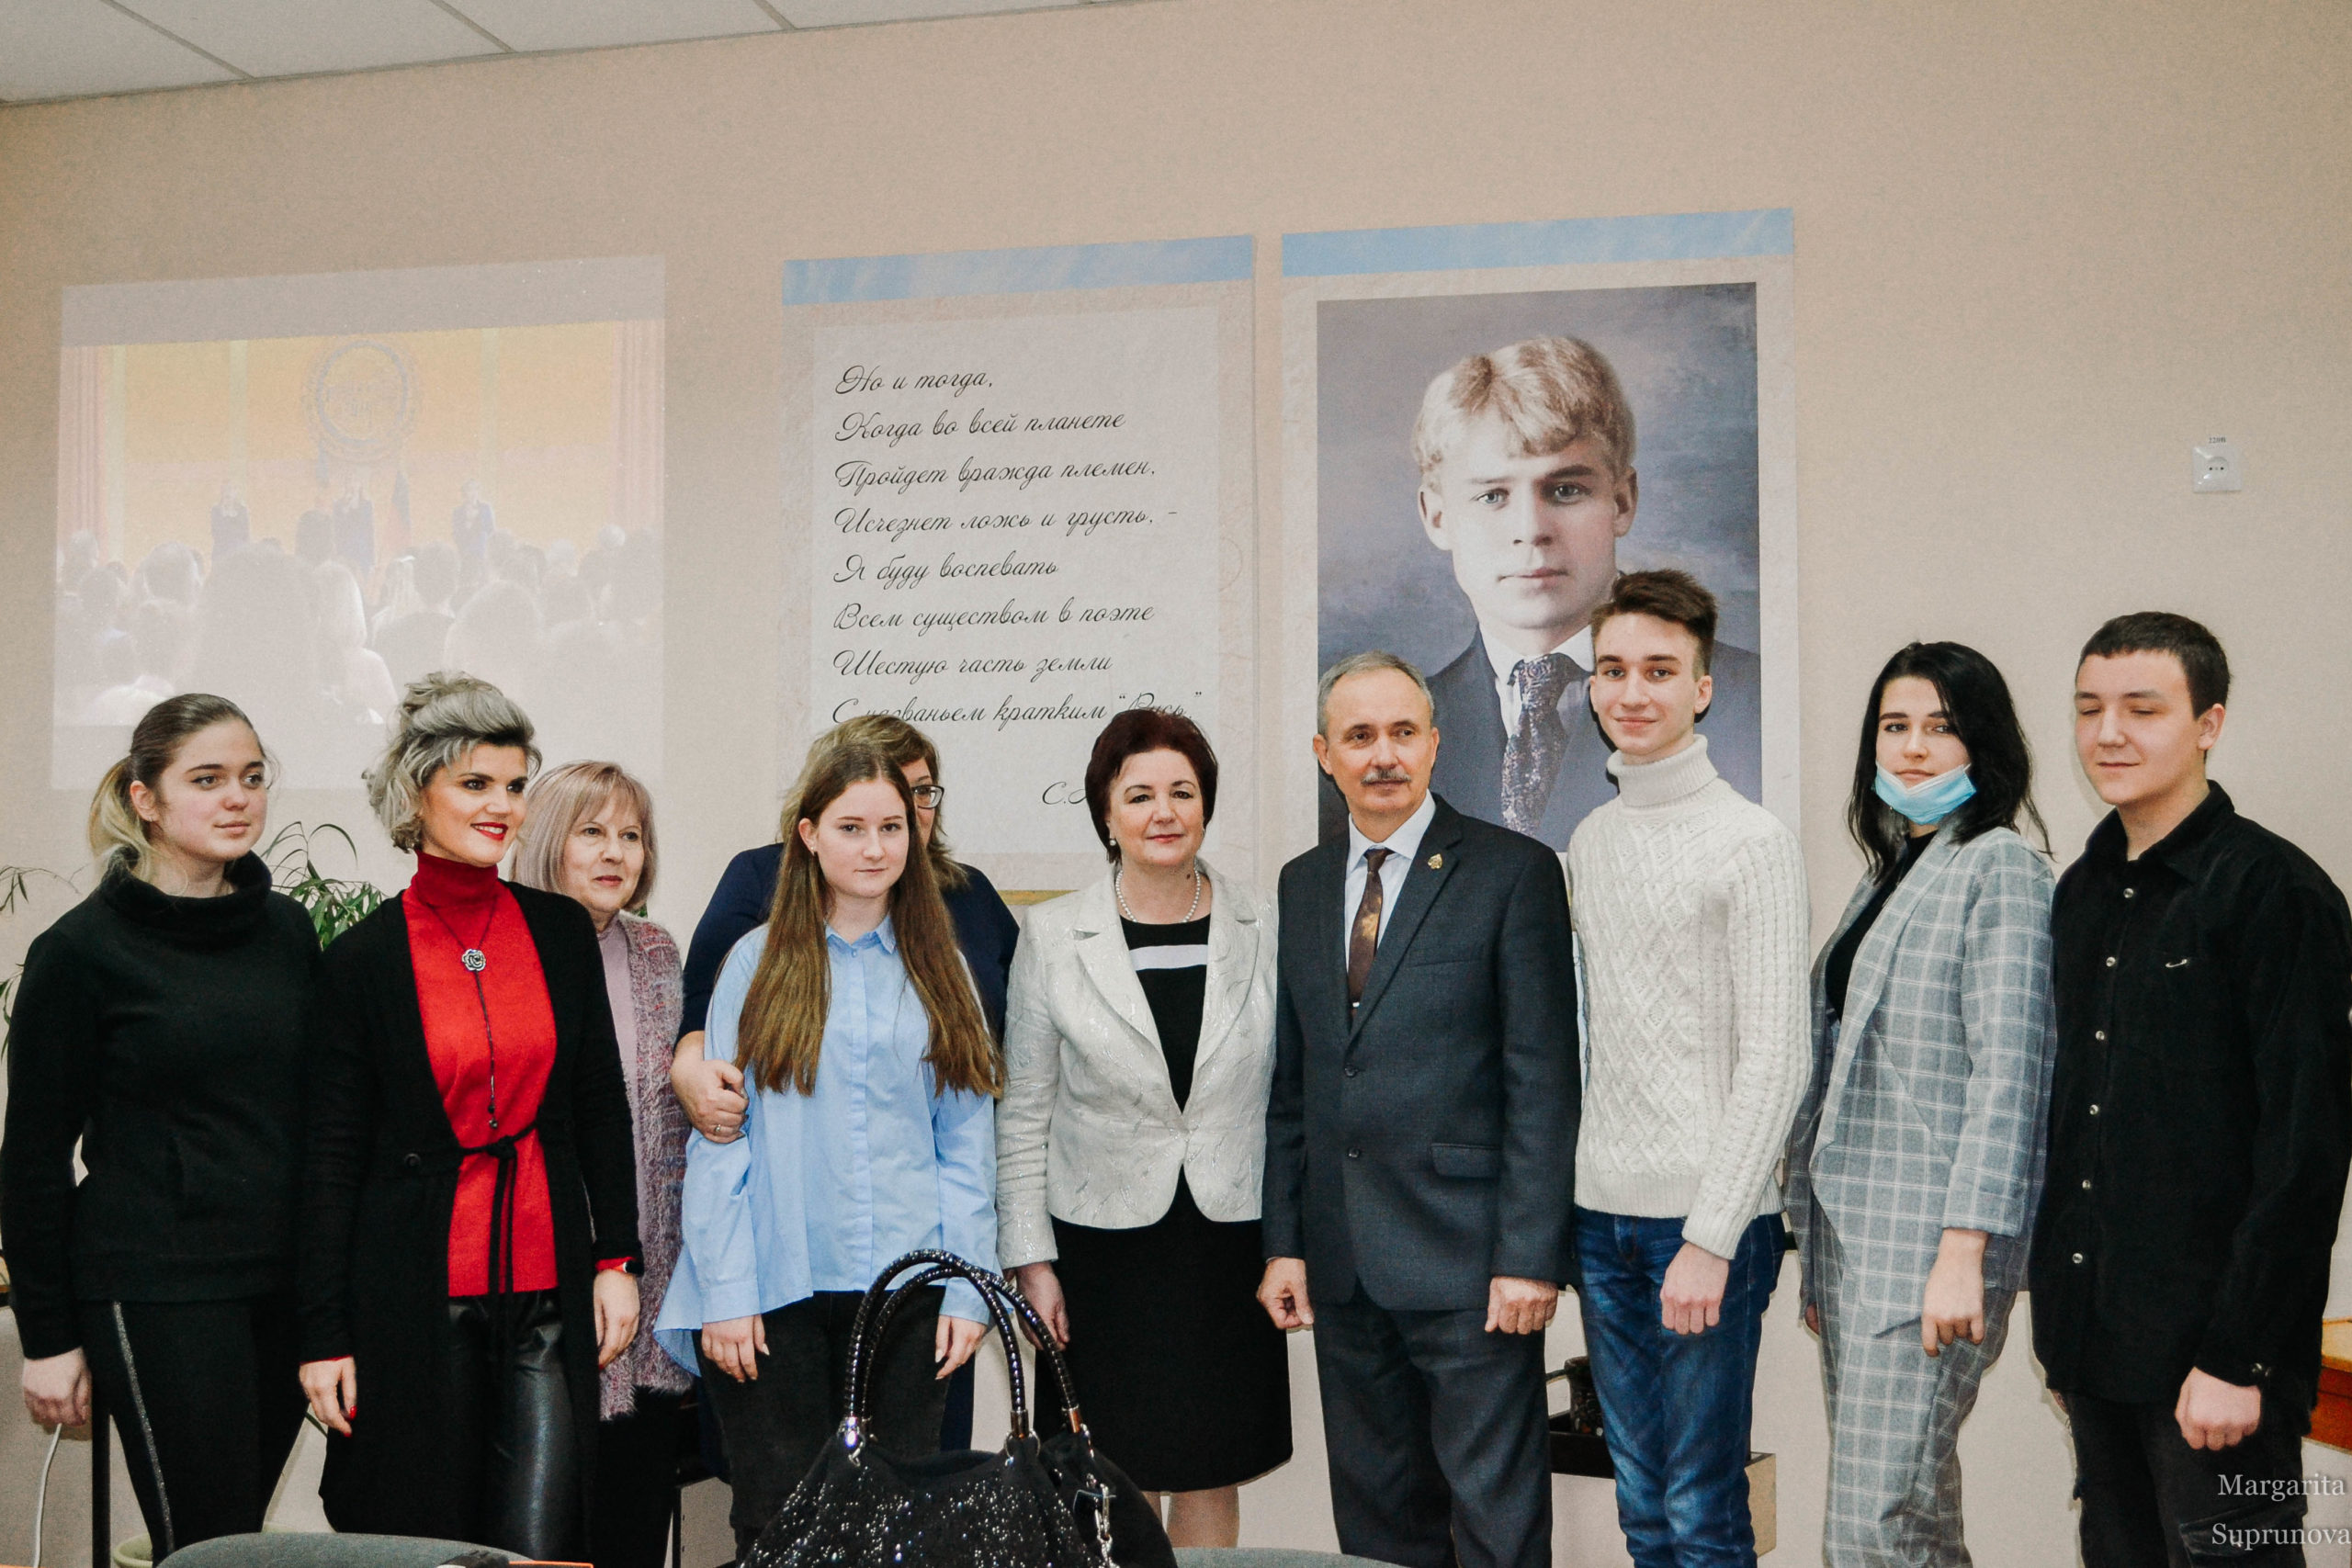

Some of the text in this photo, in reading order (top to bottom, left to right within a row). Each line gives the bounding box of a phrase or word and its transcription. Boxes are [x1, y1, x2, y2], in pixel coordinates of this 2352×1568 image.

[835, 366, 884, 394] Но
[893, 377, 908, 389] и
[835, 408, 1126, 447] Когда во всей планете
[835, 460, 948, 496] Пройдет
[958, 457, 1053, 492] вражда
[834, 508, 953, 542] Исчезнет
[961, 514, 1032, 529] ложь
[1041, 514, 1056, 526] и
[834, 550, 1058, 590] Я буду воспевать
[833, 596, 1155, 637] Всем существом в поэте
[833, 650, 1113, 684] Шестую часть земли
[832, 698, 859, 723] С
[993, 694, 1107, 733] кратким
